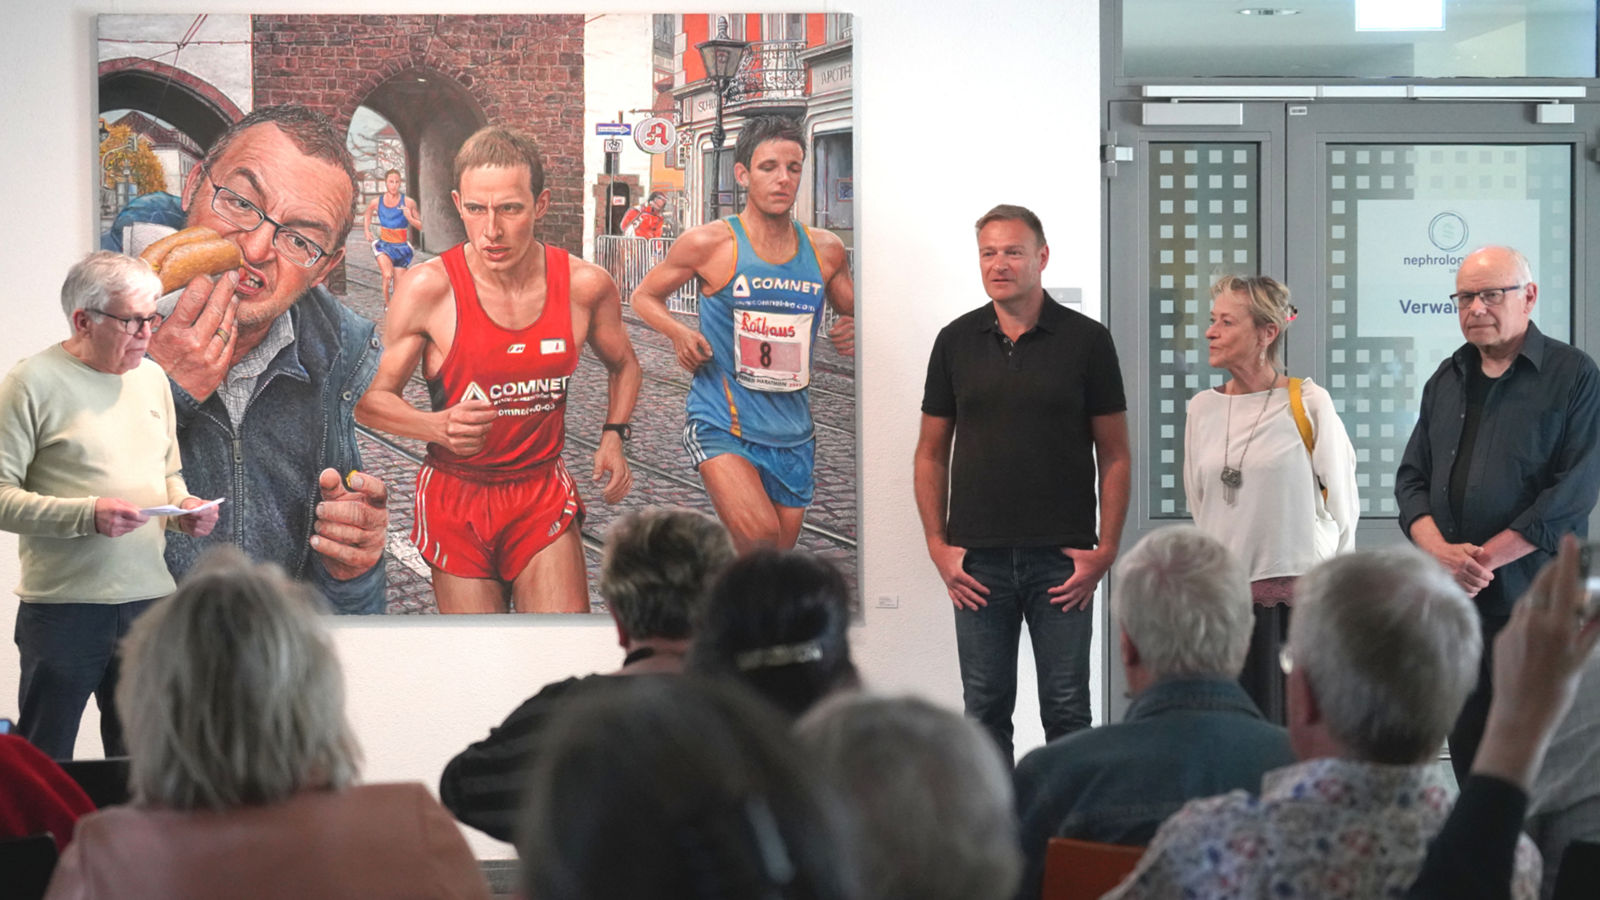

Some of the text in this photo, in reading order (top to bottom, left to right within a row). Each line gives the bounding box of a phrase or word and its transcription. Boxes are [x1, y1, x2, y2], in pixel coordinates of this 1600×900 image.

[644, 122, 668, 146] A
[751, 277, 822, 296] COMNET
[741, 311, 796, 338] Rothaus
[760, 341, 772, 368] 8
